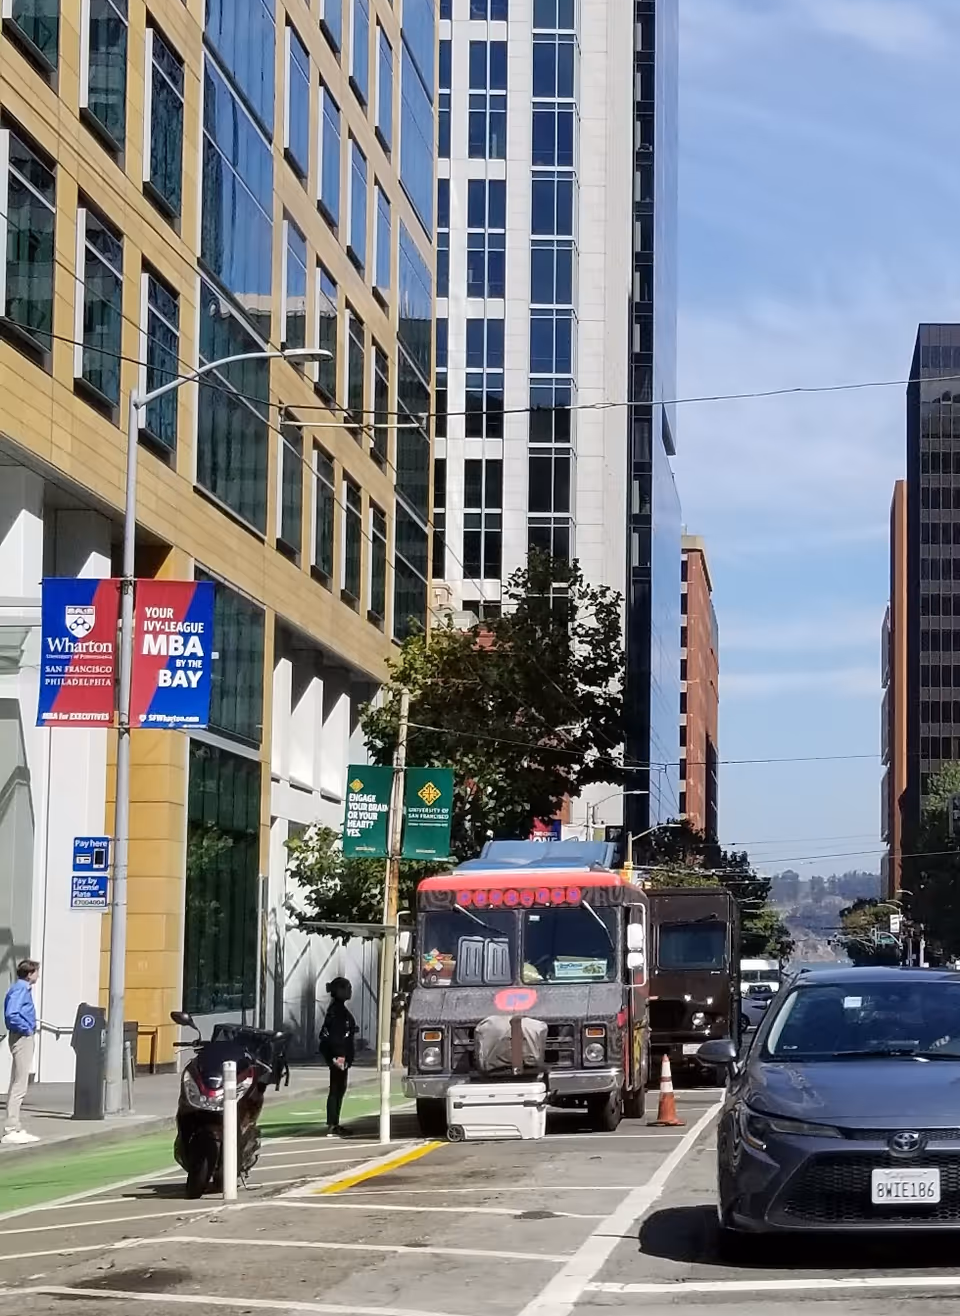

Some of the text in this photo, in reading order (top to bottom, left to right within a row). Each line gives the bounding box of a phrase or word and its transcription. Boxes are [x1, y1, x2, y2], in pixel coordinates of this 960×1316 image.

[145, 607, 174, 619] YOUR
[143, 621, 205, 633] IVY-LEAGUE
[47, 637, 113, 653] Wharton
[141, 634, 205, 657] MBA
[176, 659, 203, 668] BY THE
[45, 665, 112, 674] SAN FRANCISCO
[45, 678, 112, 686] PHILADELPHIA
[158, 670, 204, 689] BAY
[69, 712, 110, 721] EXECUTIVES
[349, 793, 377, 803] ENGAGE
[348, 802, 368, 812] YOUR
[347, 811, 378, 821] OR YOUR
[346, 820, 374, 829] HEART?
[75, 839, 107, 849] Pay here
[73, 876, 98, 886] Pay by
[73, 883, 100, 891] License
[84, 1017, 92, 1026] P
[876, 1181, 935, 1198] 8WIE186
